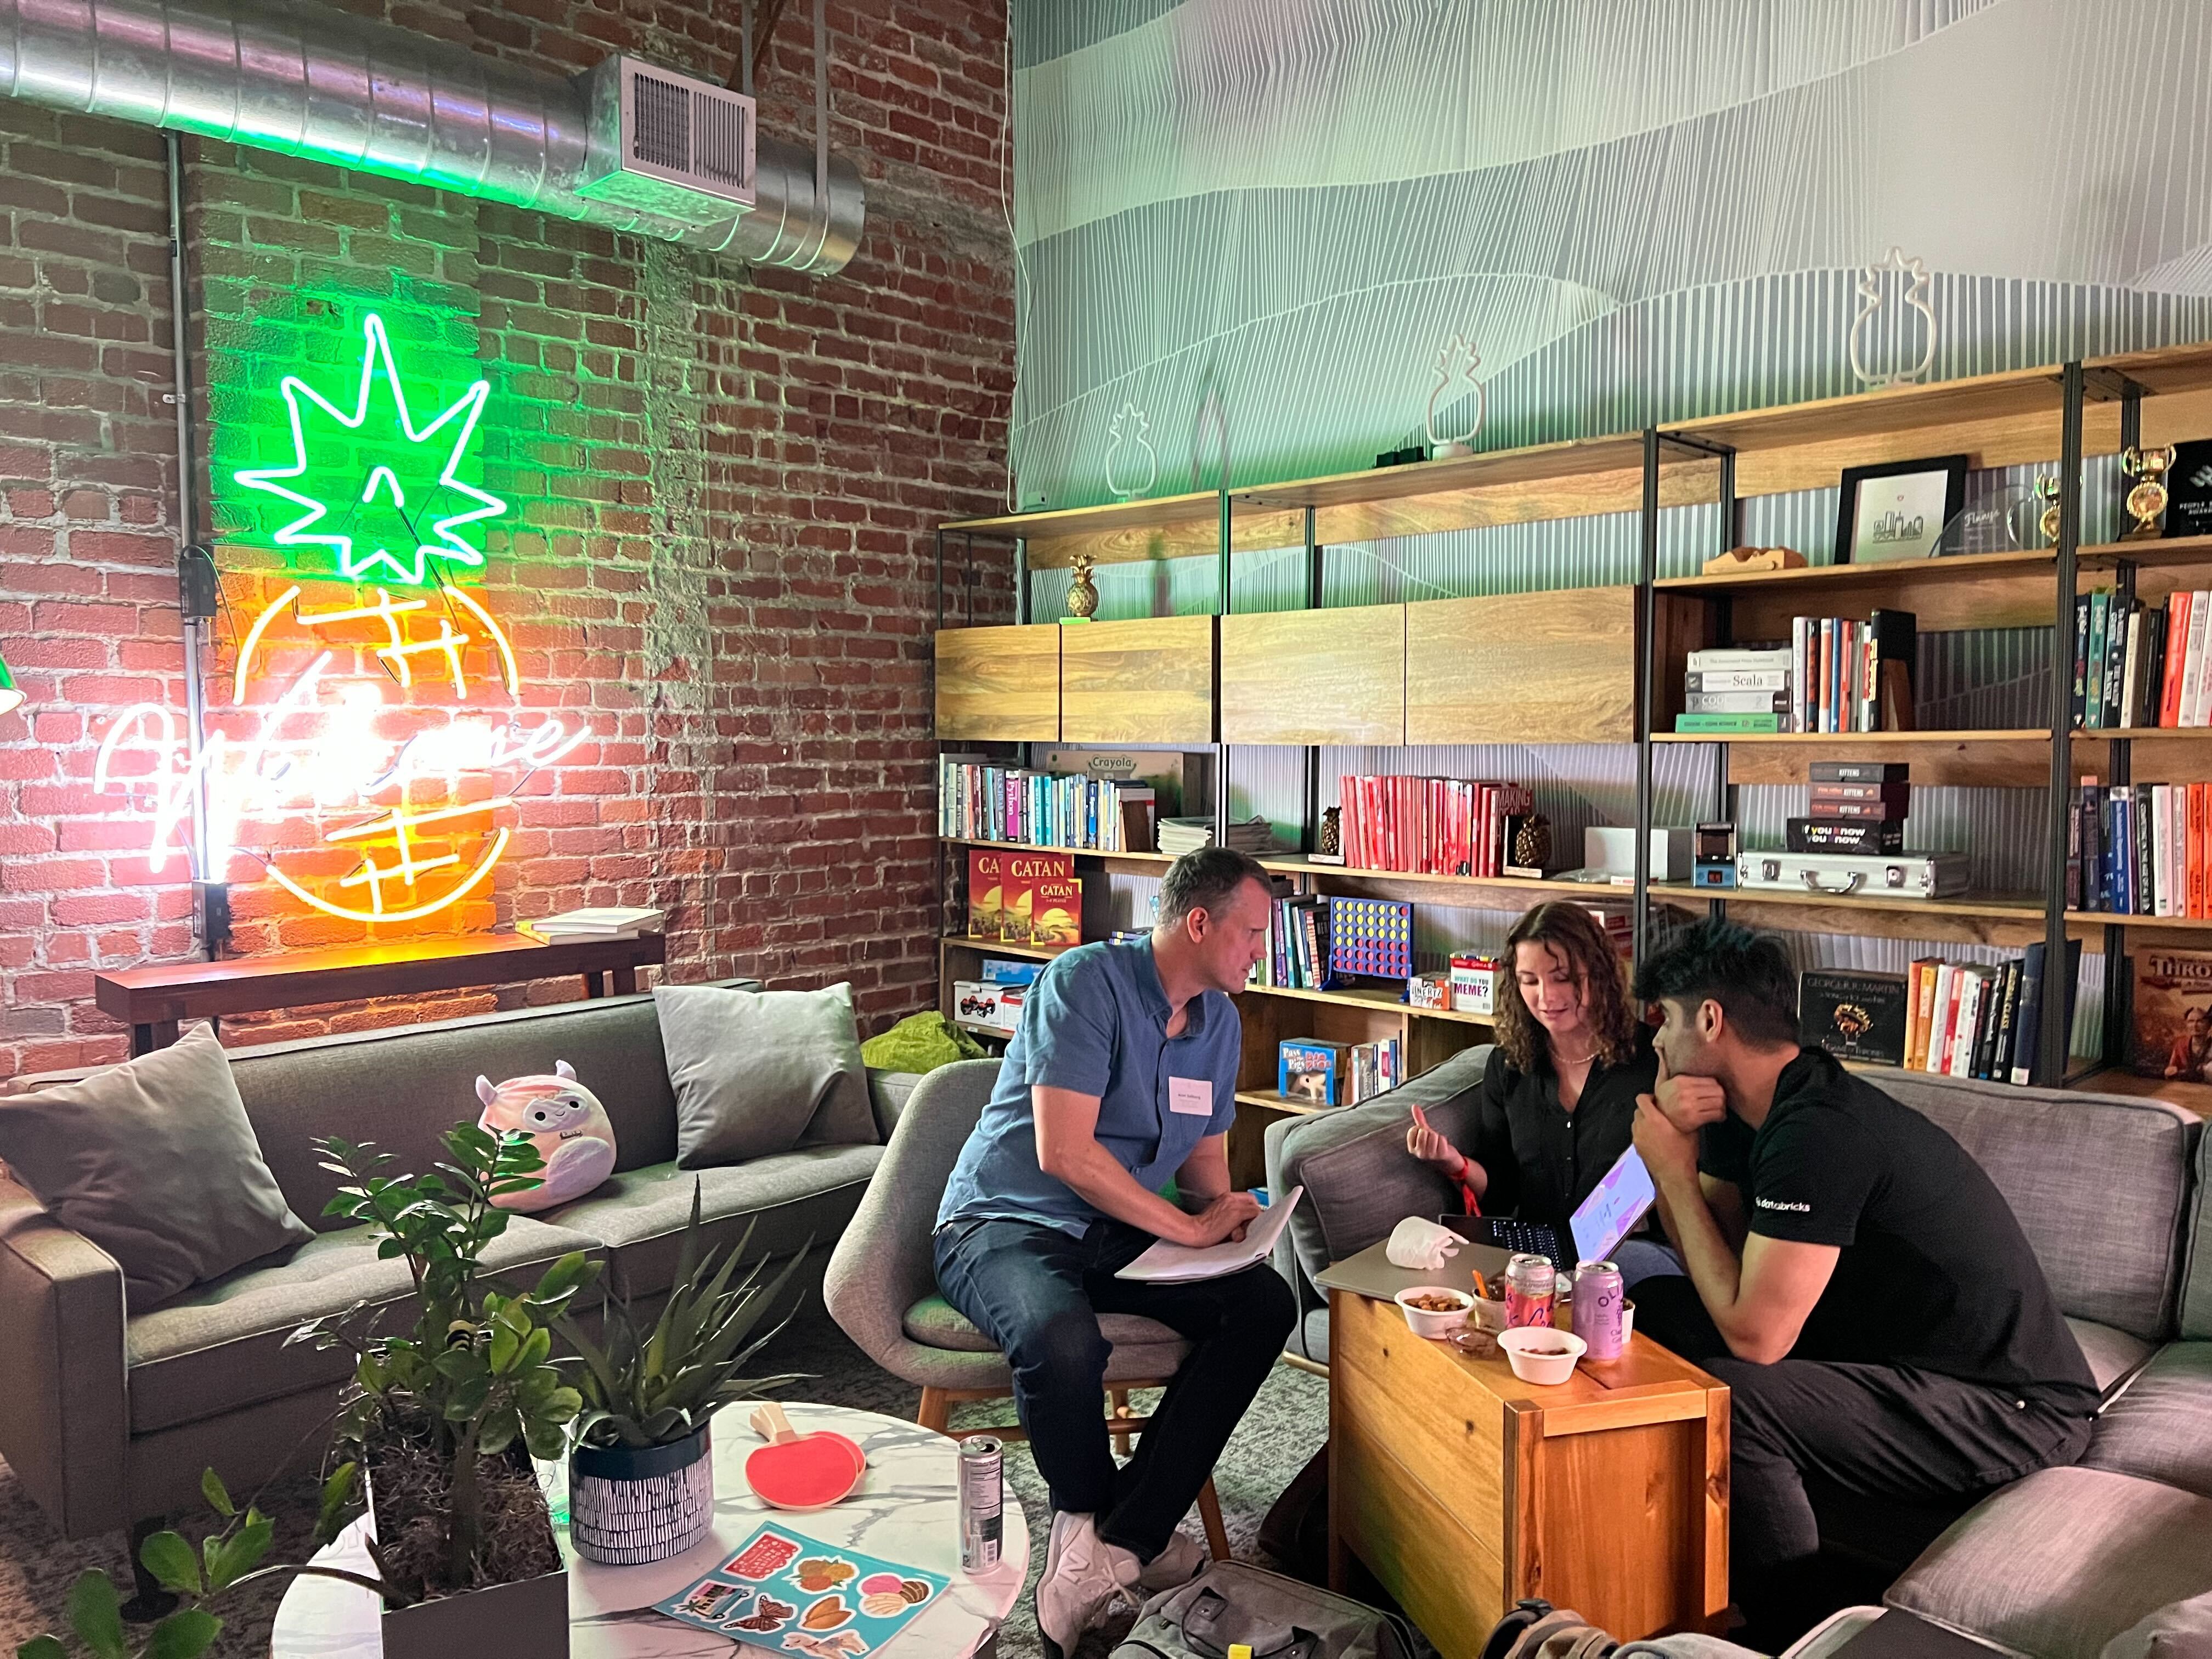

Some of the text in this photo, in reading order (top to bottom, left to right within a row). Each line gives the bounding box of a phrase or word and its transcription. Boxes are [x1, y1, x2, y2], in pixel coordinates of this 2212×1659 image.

[1733, 674, 1763, 687] Scala
[94, 653, 593, 884] Welme
[1092, 757, 1132, 769] Crayola
[1839, 769, 1860, 777] KITTENS
[1007, 780, 1016, 816] Python
[1496, 789, 1531, 807] MAKING
[1843, 788, 1864, 797] KITTENS
[1839, 806, 1861, 814] KITTENS
[1812, 827, 1832, 836] you
[1833, 827, 1866, 836] know
[1807, 835, 1827, 843] you
[978, 857, 1001, 874] CA
[1011, 860, 1065, 877] CATAN
[1040, 885, 1073, 896] CATAN
[1454, 975, 1469, 984] WHAT
[1454, 983, 1489, 997] MEME?
[1861, 983, 1899, 994] MARTIN
[2001, 1002, 2012, 1030] CLASS
[1283, 1047, 1301, 1058] Pass
[1288, 1058, 1306, 1072] Pigs
[1761, 1198, 1811, 1212] databricks
